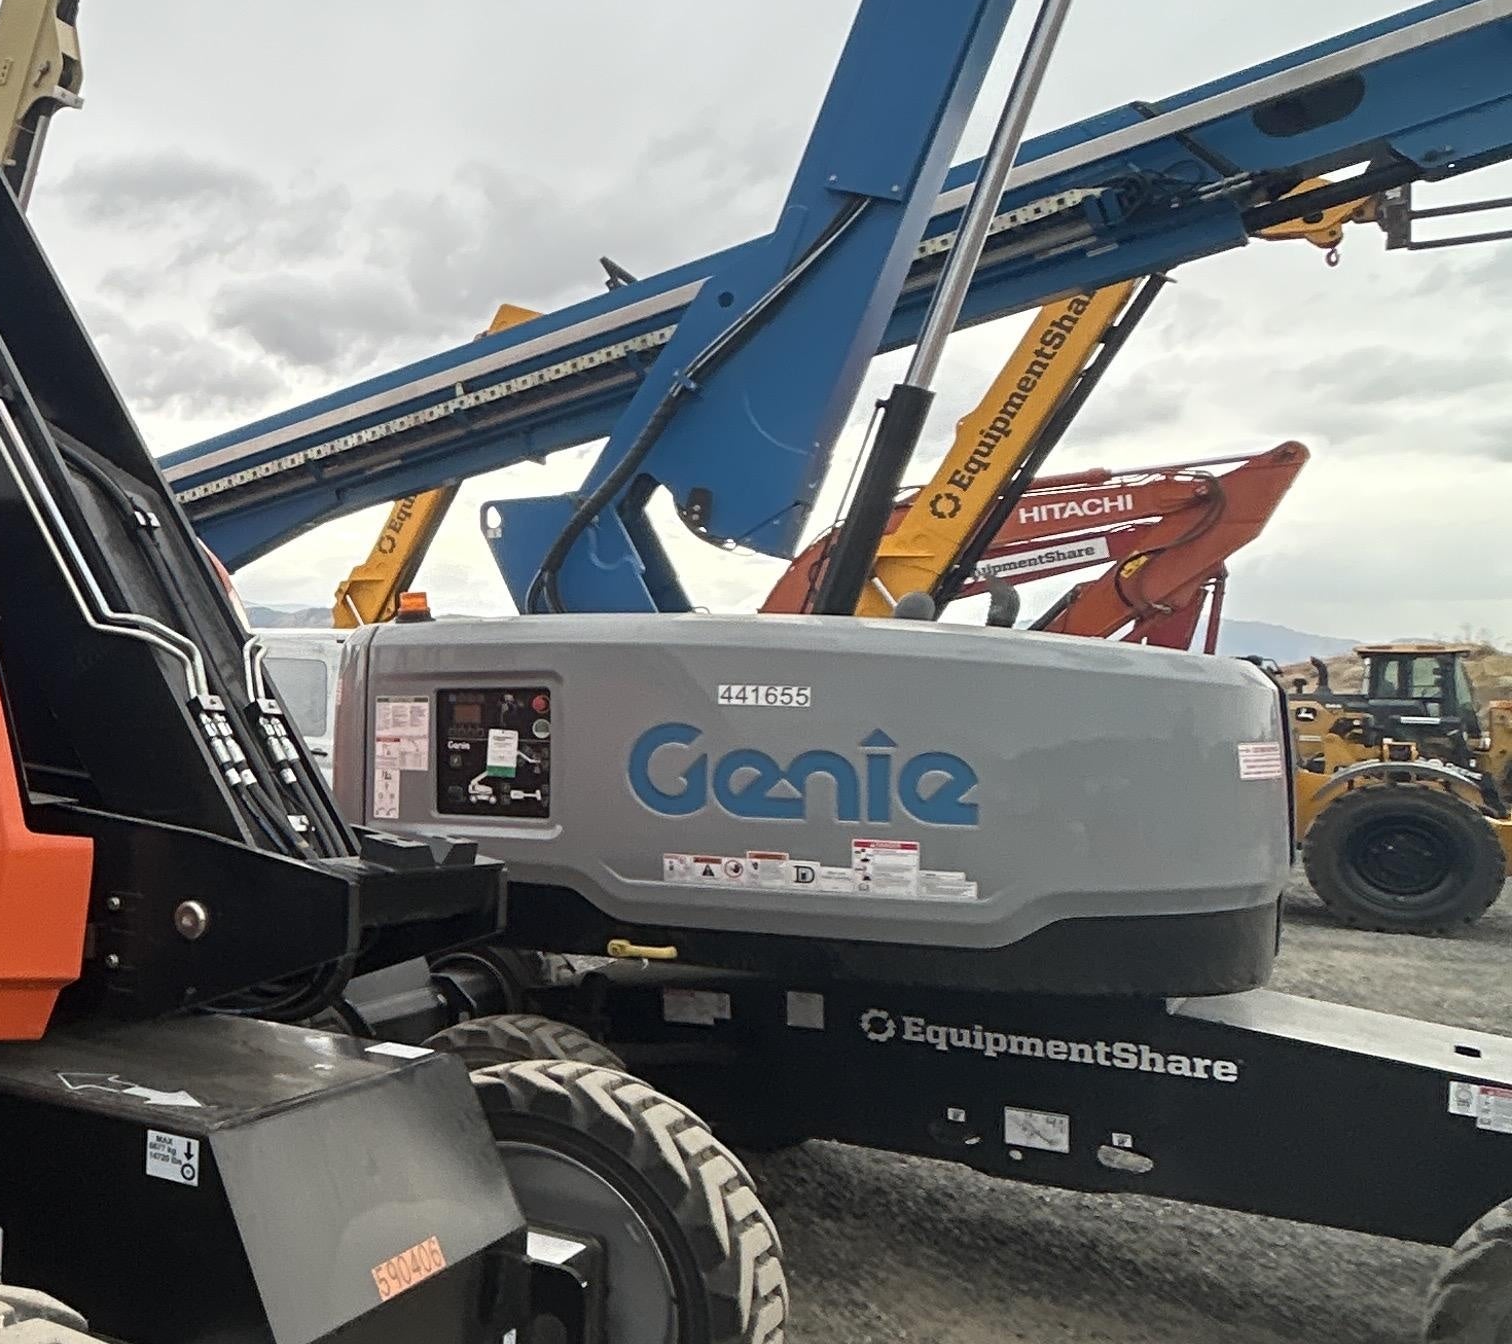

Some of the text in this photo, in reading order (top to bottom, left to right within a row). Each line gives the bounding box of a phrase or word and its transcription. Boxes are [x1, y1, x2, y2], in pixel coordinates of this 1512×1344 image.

[947, 291, 1095, 492] EquipmentSha
[1018, 494, 1133, 524] HITACHI
[720, 686, 809, 706] 441655
[627, 721, 979, 826] Genie
[901, 1016, 1238, 1083] EquipmentShare
[375, 1239, 442, 1297] 590406
